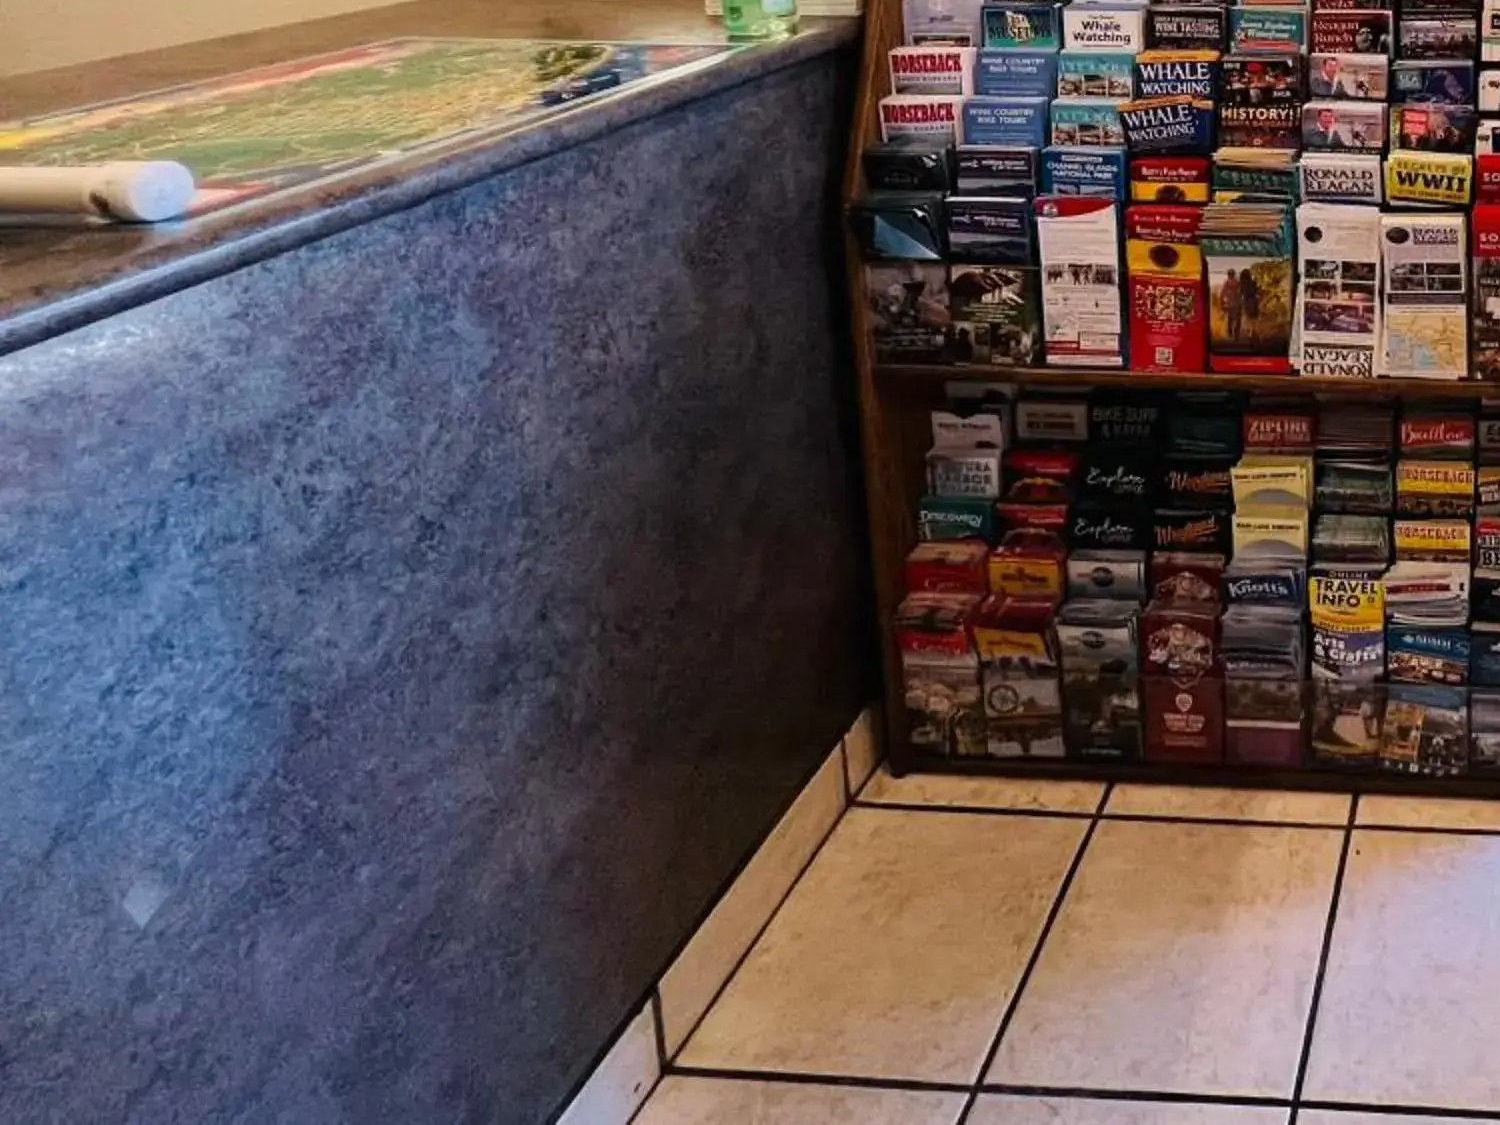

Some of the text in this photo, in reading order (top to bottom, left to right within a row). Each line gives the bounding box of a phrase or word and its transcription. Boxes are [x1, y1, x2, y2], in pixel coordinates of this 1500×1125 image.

[1081, 21, 1121, 32] Whale
[1072, 31, 1131, 45] Watching
[892, 53, 962, 73] HORSEBACK
[1140, 62, 1211, 80] WHALE
[1141, 81, 1211, 95] WATCHING
[882, 103, 955, 124] HORSEBACK
[994, 108, 1034, 117] COUNTRY
[1123, 104, 1193, 127] WHALE
[1221, 106, 1294, 120] HISTORY!
[1128, 122, 1196, 142] WATCHING
[1304, 165, 1373, 180] RONALD
[1305, 180, 1374, 192] REAGAN
[1395, 171, 1466, 192] WWII
[1086, 466, 1146, 488] Explore
[920, 510, 983, 528] Discovery
[1227, 579, 1289, 597] Knott's
[1316, 579, 1378, 595] TRAVEL
[1316, 594, 1361, 608] INFO
[1313, 632, 1346, 649] Arts
